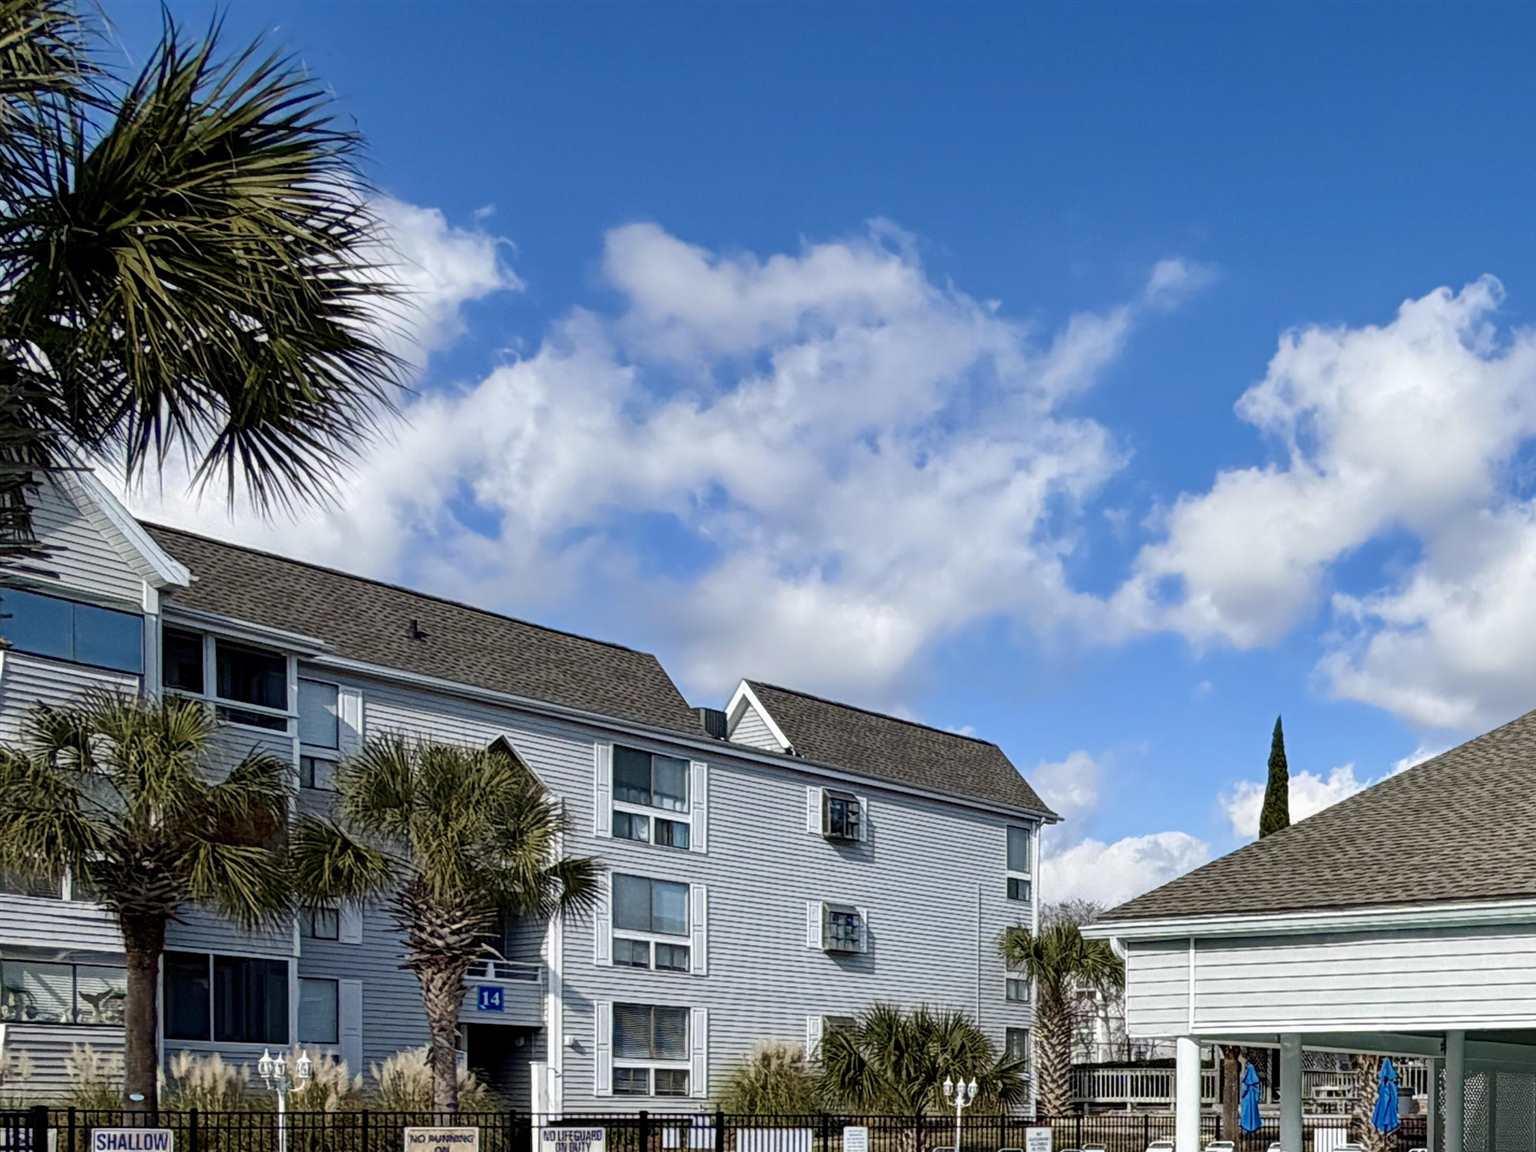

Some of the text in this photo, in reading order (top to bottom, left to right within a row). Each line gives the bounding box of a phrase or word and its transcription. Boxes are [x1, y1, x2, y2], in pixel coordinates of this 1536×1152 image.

[482, 991, 500, 1006] 14
[96, 1133, 168, 1151] SHALLOW
[410, 1134, 474, 1144] NO RUNNING
[543, 1129, 602, 1142] NO LIFEGUARD
[555, 1142, 591, 1152] ON DUTY
